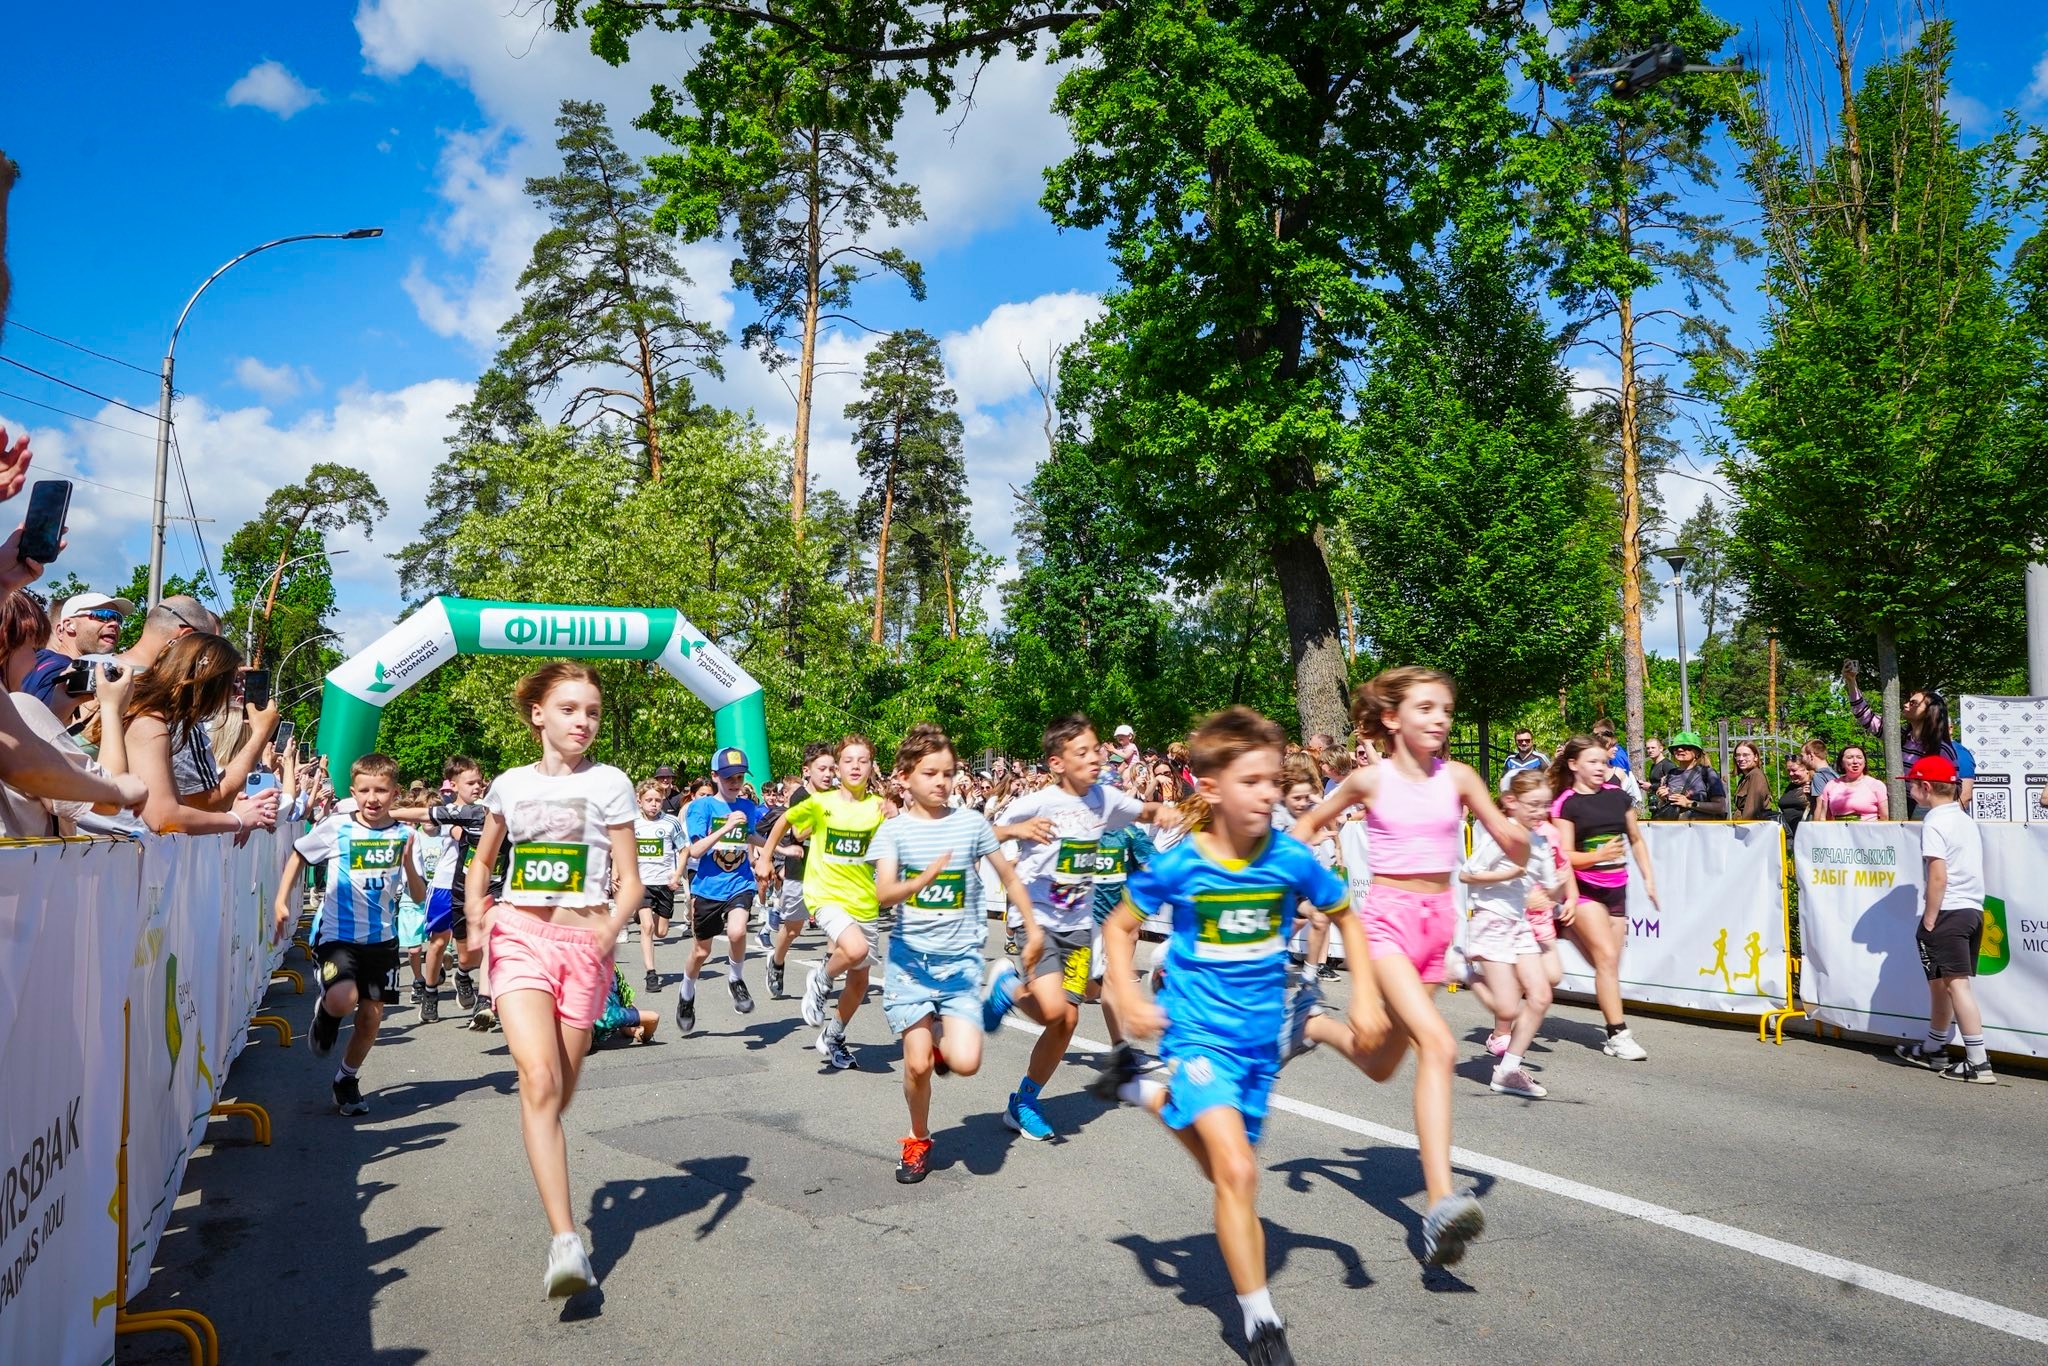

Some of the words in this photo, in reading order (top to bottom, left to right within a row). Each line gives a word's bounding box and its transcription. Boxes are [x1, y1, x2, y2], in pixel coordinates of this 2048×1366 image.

[504, 615, 626, 646] ФІНІШ
[382, 639, 434, 679] Бучанська
[396, 645, 439, 678] громада
[695, 645, 737, 683] Бучанська
[696, 657, 733, 688] громада
[364, 848, 395, 864] 458
[639, 844, 657, 854] 530
[835, 838, 861, 854] 453
[1812, 845, 1896, 866] БУЧАНСЬКИЙ
[524, 860, 570, 883] 508
[1812, 868, 1848, 886] ЗАБІГ
[1854, 869, 1896, 889] МИРУ
[917, 884, 955, 903] 424
